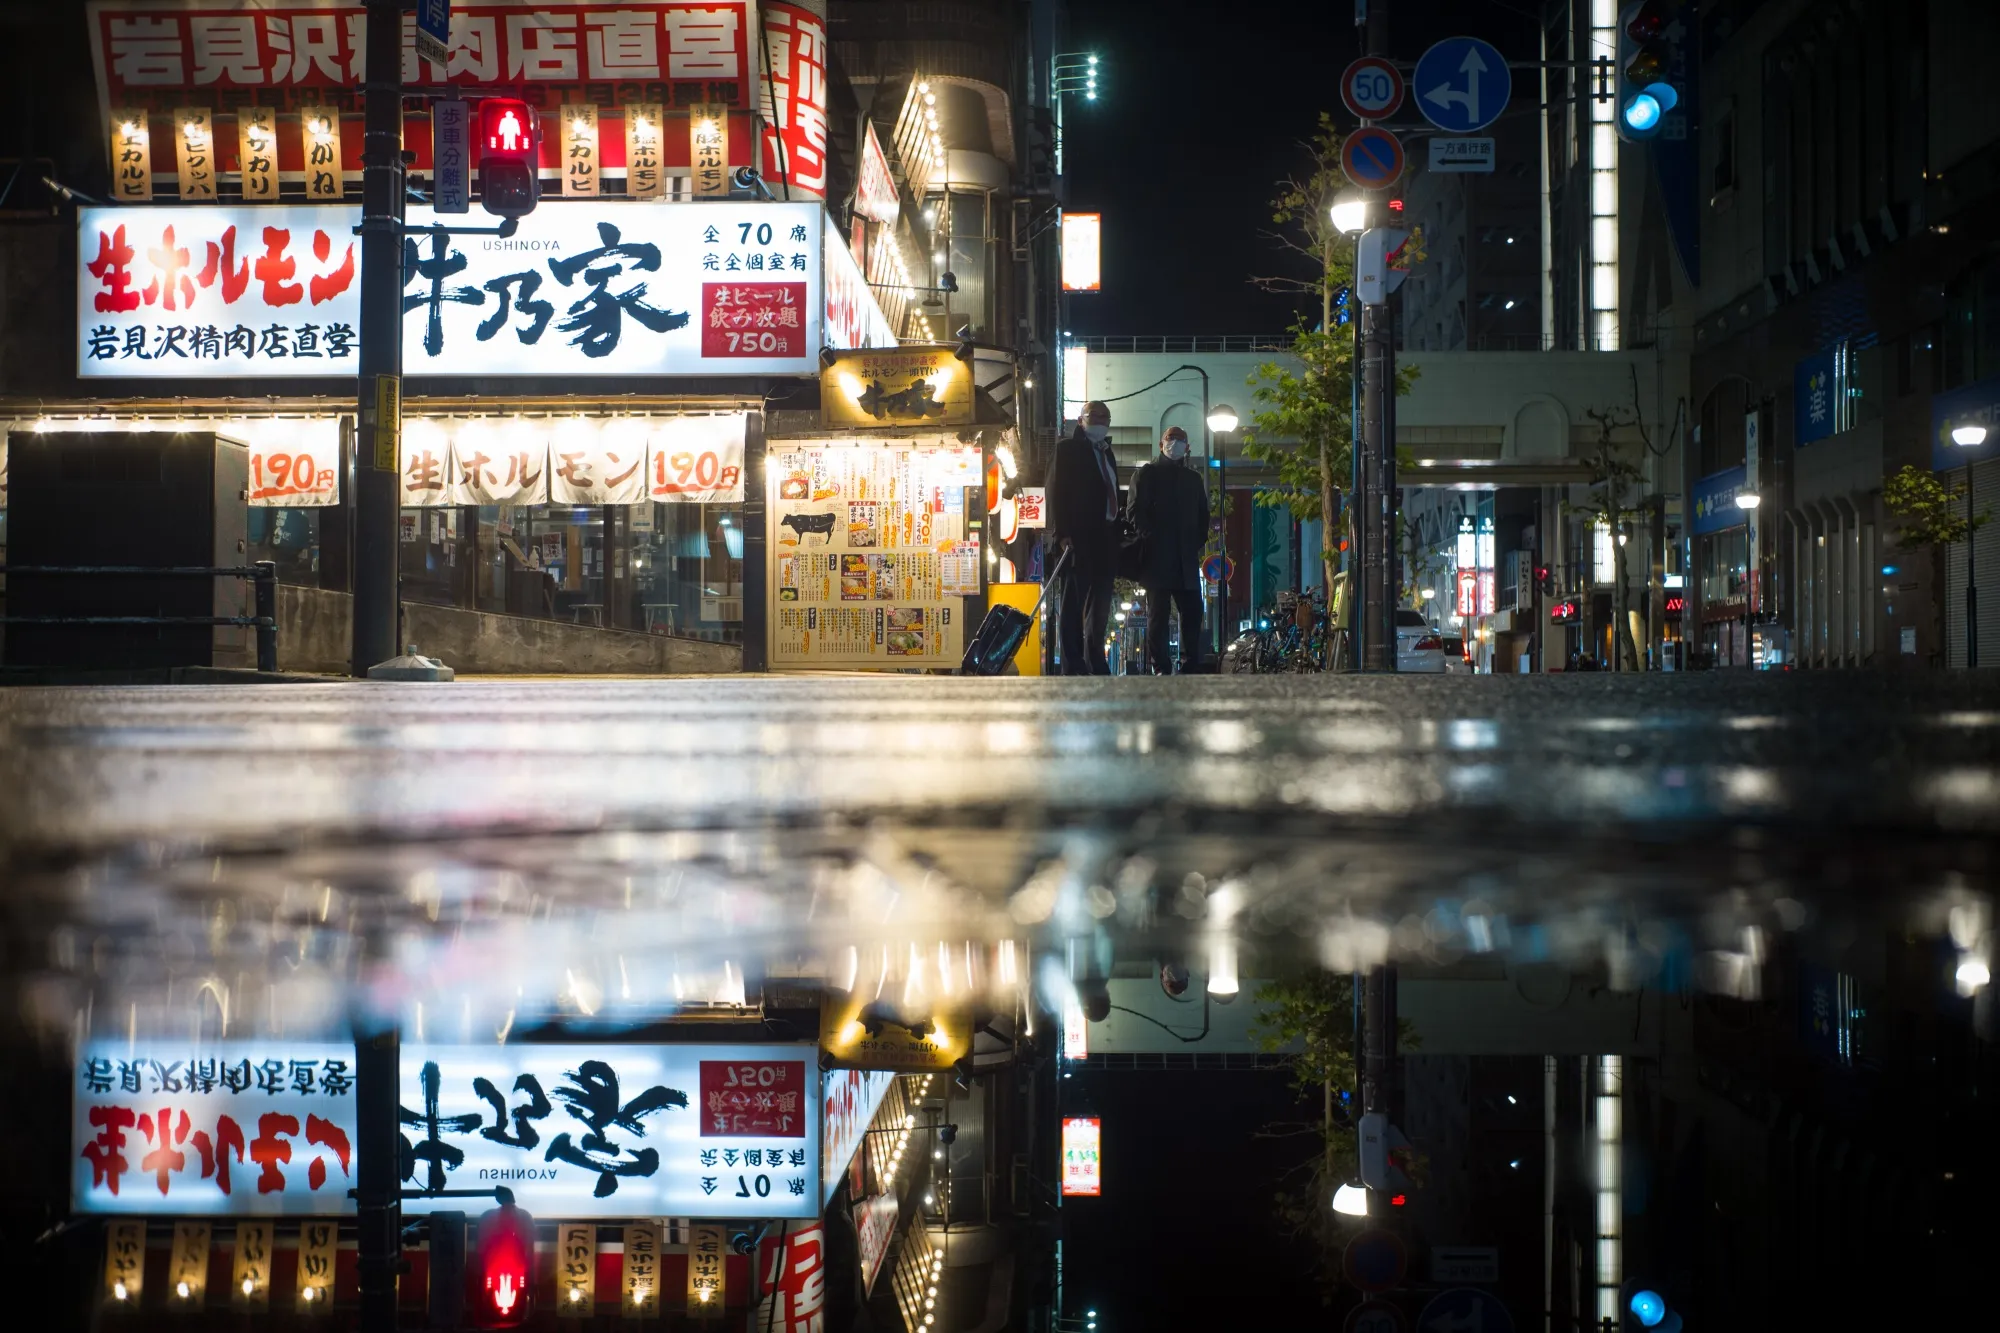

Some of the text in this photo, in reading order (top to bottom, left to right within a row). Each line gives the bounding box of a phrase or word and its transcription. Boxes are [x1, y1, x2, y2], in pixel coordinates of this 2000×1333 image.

[1356, 75, 1389, 101] 50
[442, 107, 461, 208] 歩車分離式
[1434, 142, 1491, 154] 一方通行路
[483, 240, 561, 251] USHINOYA
[702, 222, 807, 246] 全 70 席
[86, 224, 355, 313] 生ホルモン
[702, 252, 807, 272] 完全個室有
[403, 222, 691, 358] 牛乃家
[714, 286, 795, 306] 生ビール
[709, 306, 799, 329] 飲み放題
[87, 323, 356, 360] 岩見沢精肉店直営
[724, 332, 788, 353] 750円
[251, 453, 335, 490] 190円
[405, 450, 640, 492] 生ホルモン
[653, 451, 740, 487] 190円
[922, 502, 931, 544] 190円
